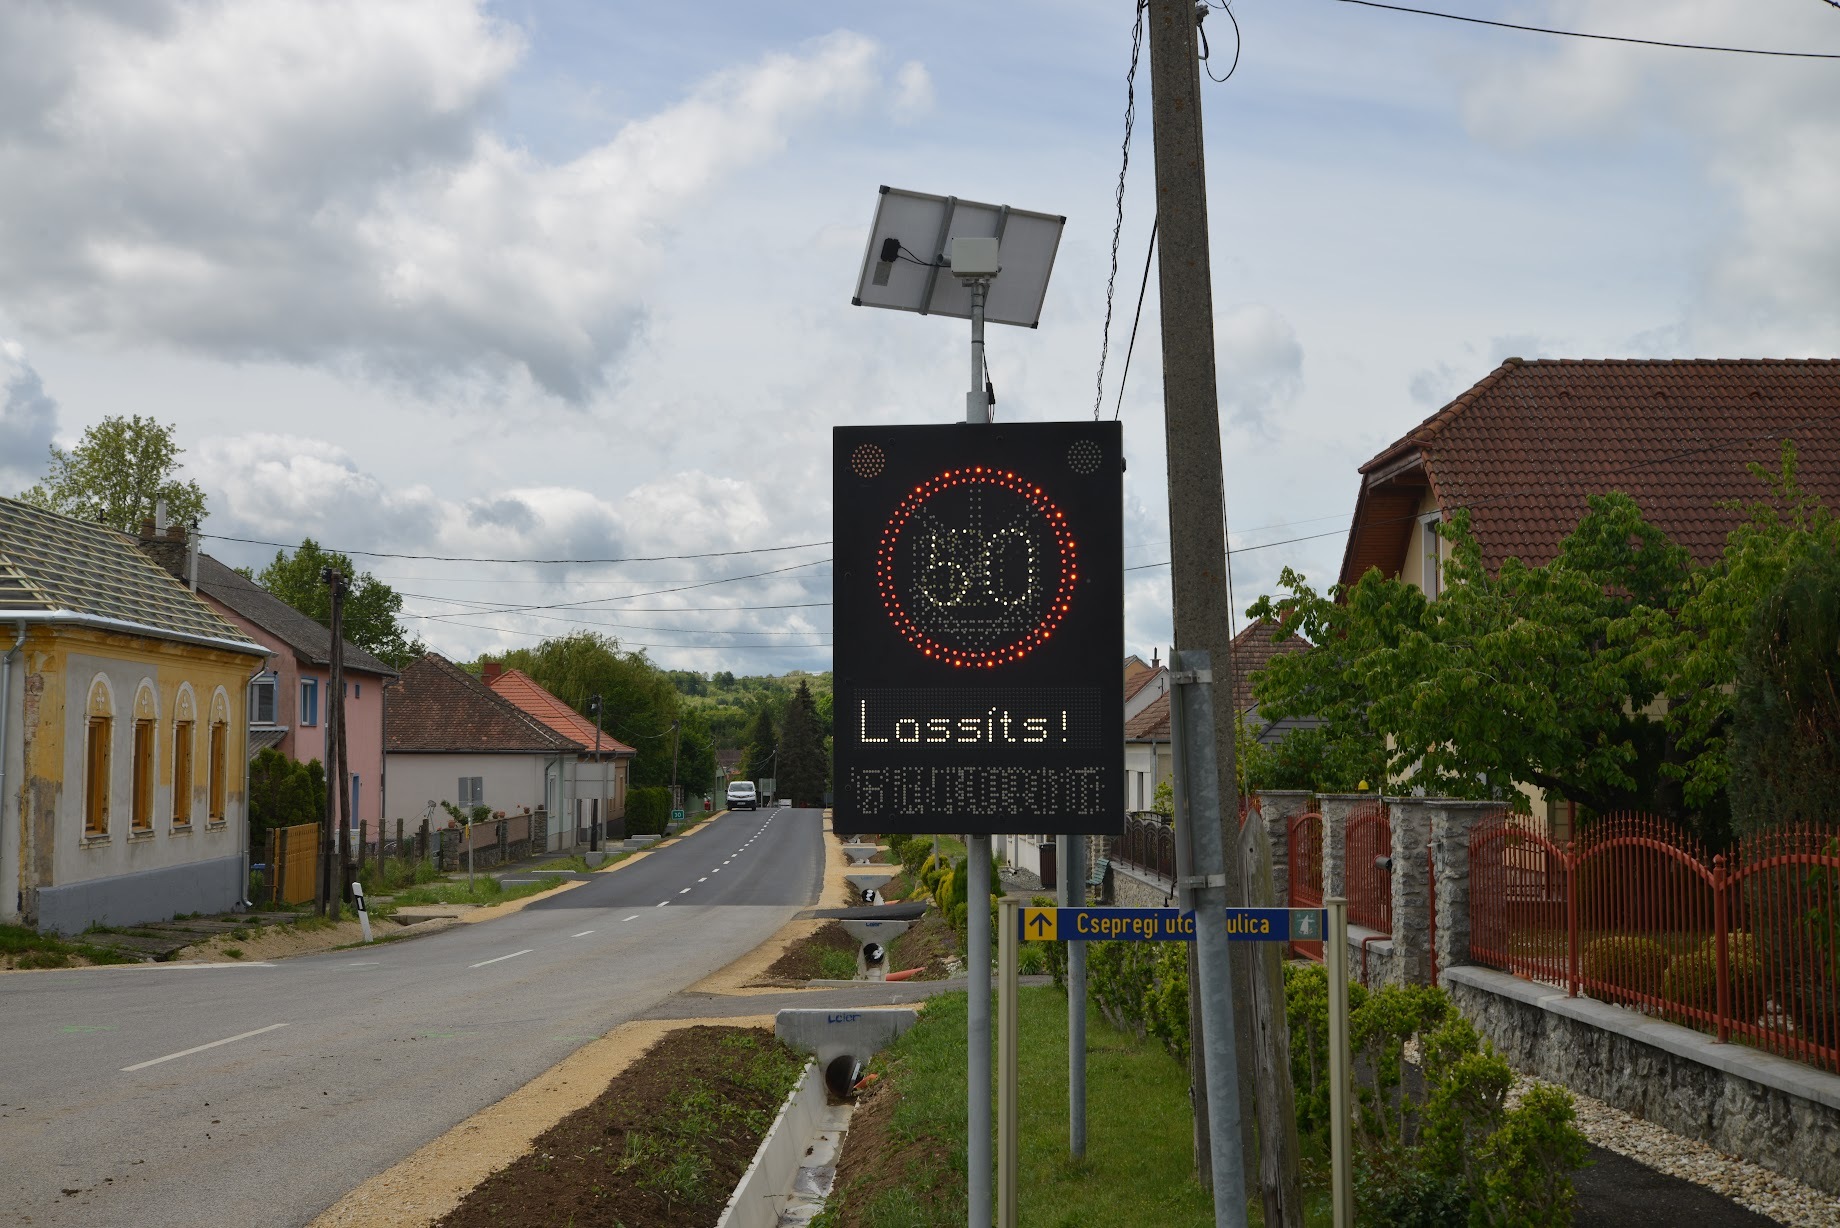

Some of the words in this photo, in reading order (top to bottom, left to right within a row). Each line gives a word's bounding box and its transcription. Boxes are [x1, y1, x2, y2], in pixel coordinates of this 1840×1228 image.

[923, 528, 1033, 606] 50
[1077, 912, 1159, 938] Csepregi
[1165, 914, 1197, 934] utc
[1226, 913, 1270, 934] ulica
